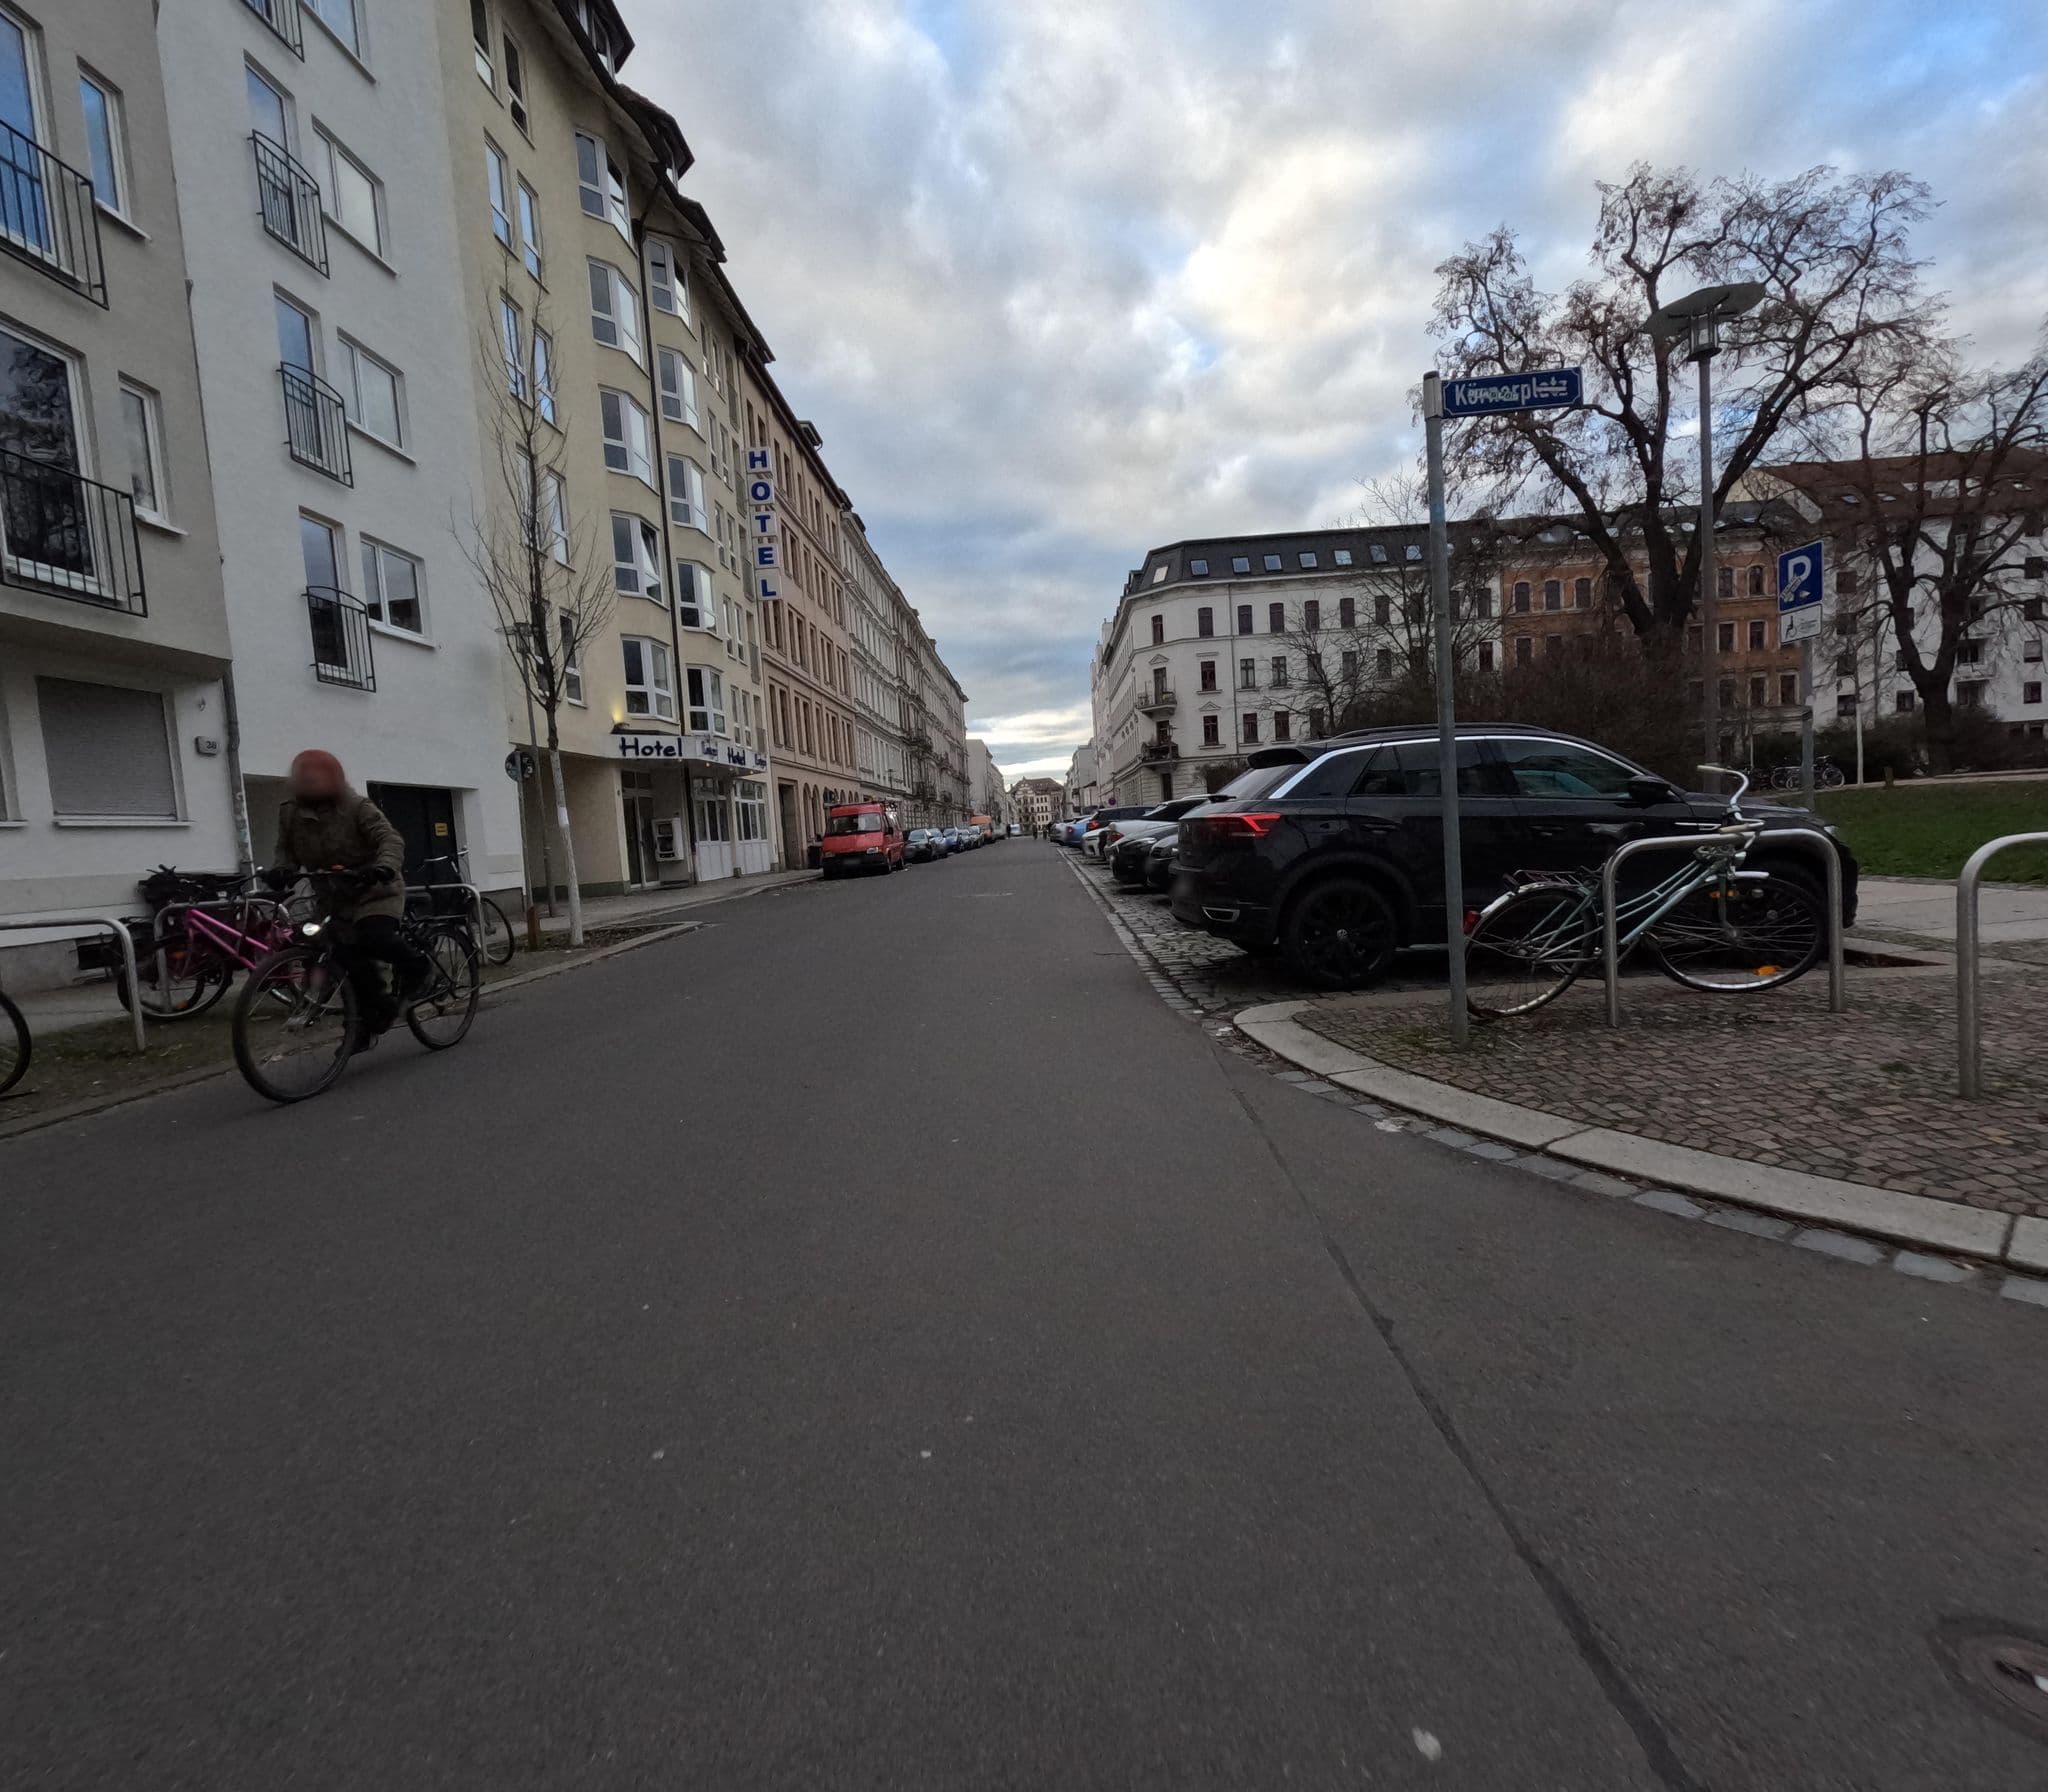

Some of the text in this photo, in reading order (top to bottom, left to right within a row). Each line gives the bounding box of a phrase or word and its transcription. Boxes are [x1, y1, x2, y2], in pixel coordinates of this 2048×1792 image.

[748, 450, 777, 597] HOTEL
[620, 737, 683, 757] Hotel
[727, 746, 746, 766] Hotel
